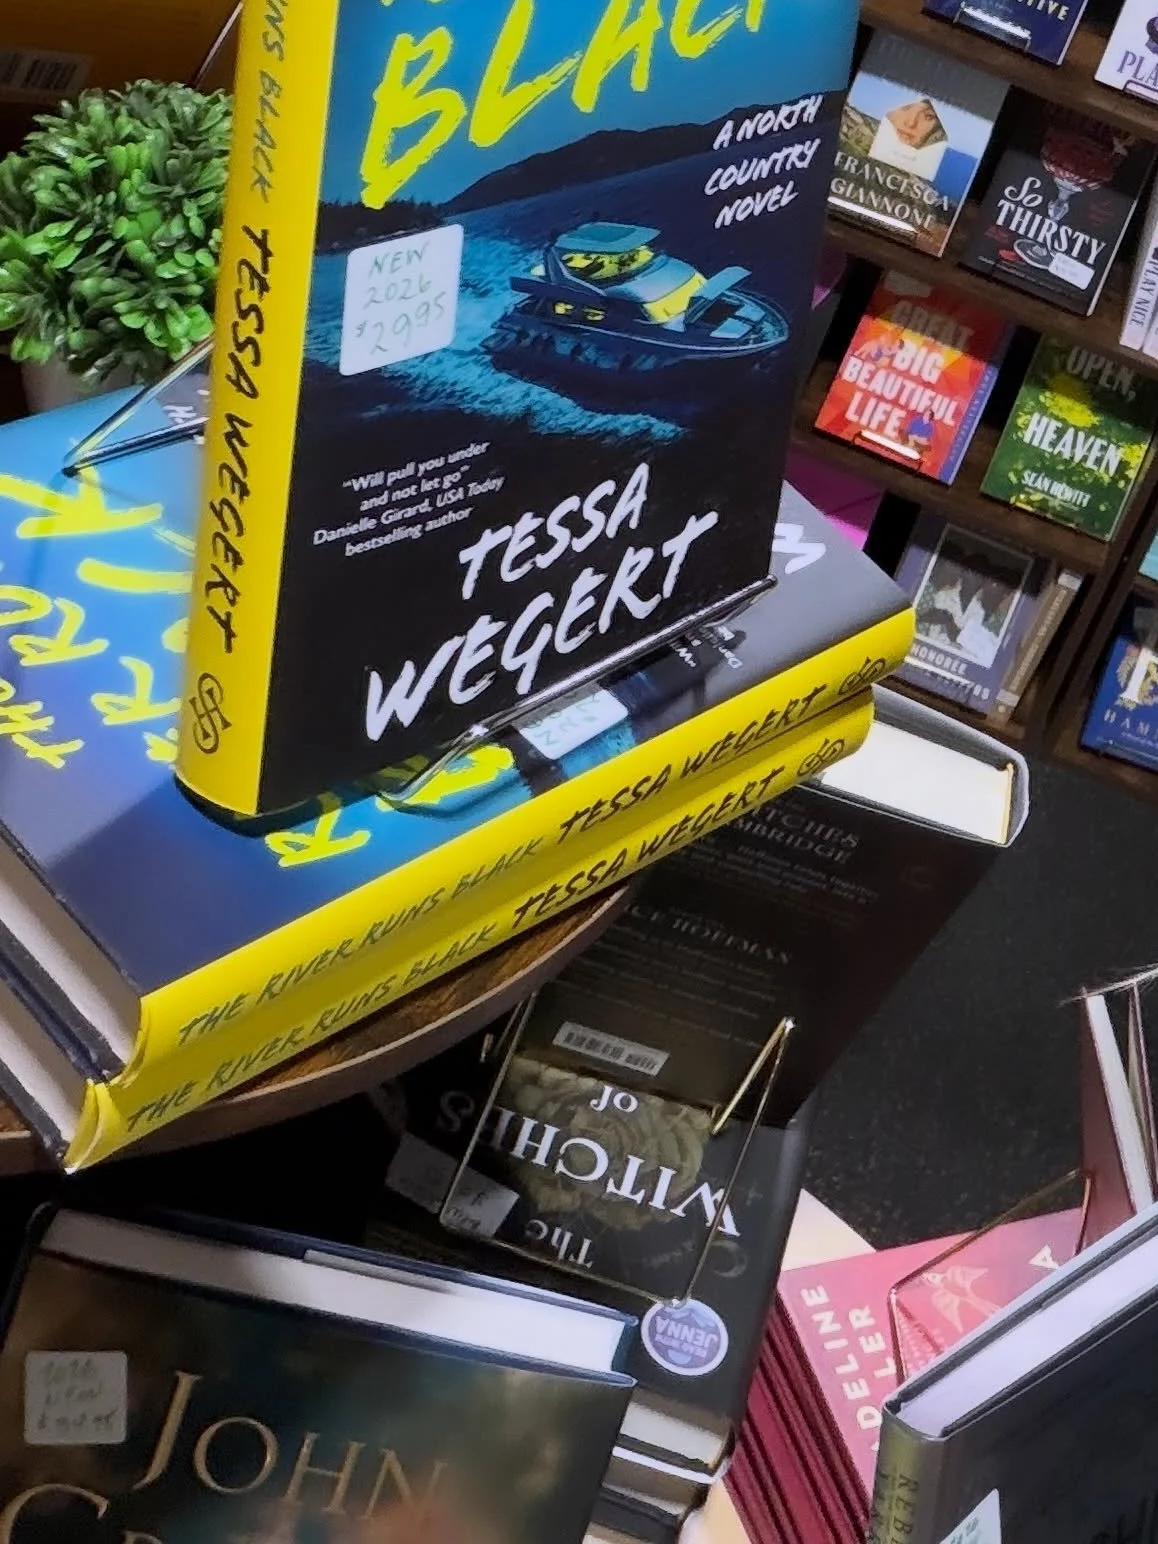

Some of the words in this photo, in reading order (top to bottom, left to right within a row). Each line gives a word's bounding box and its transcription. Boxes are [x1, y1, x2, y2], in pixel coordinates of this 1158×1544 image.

[249, 69, 284, 204] BLACK
[711, 118, 733, 152] A
[735, 93, 826, 144] NORTH
[702, 137, 822, 198] COUNTRY
[834, 151, 950, 212] FRANCESCA
[1003, 176, 1043, 208] So
[712, 179, 801, 230] NOVEL
[996, 198, 1107, 266] THIRSTY
[367, 240, 431, 278] NEW
[225, 224, 275, 400] TESSA
[363, 275, 433, 305] 2026
[1128, 302, 1152, 329] NICE
[841, 357, 962, 427] BEAUTIFUL
[894, 342, 946, 384] BIG
[845, 394, 907, 439] LIFE
[1022, 412, 1125, 478] HEAVEN
[387, 459, 416, 488] pull
[418, 452, 447, 475] you
[447, 440, 491, 465] under
[312, 514, 377, 547] Danielle
[379, 500, 434, 525] Girard,
[435, 486, 466, 510] USA
[468, 474, 506, 503] Today
[359, 490, 388, 512] and
[391, 483, 418, 504] not
[420, 477, 441, 498] let
[205, 412, 254, 655] WEGERT
[342, 522, 422, 557] bestselling
[423, 505, 474, 530] author
[458, 461, 652, 600] TESSA
[363, 509, 719, 744] WEGERT
[178, 992, 250, 1046] THE
[257, 939, 354, 1005] RIVER
[361, 888, 447, 946] RUNS
[450, 837, 539, 901] BLACK
[557, 763, 672, 845] TESSA
[681, 683, 827, 779] WEGERT
[125, 1079, 200, 1133] THE
[205, 1025, 306, 1092] RIVER
[310, 974, 397, 1037] RUNS
[402, 922, 499, 989] BLACK
[512, 848, 630, 929] TESSA
[637, 765, 786, 863] WEGERT
[588, 1084, 640, 1114] of
[525, 1217, 596, 1269] The
[655, 1315, 719, 1349] JENNA
[130, 1369, 450, 1521] JOHN
